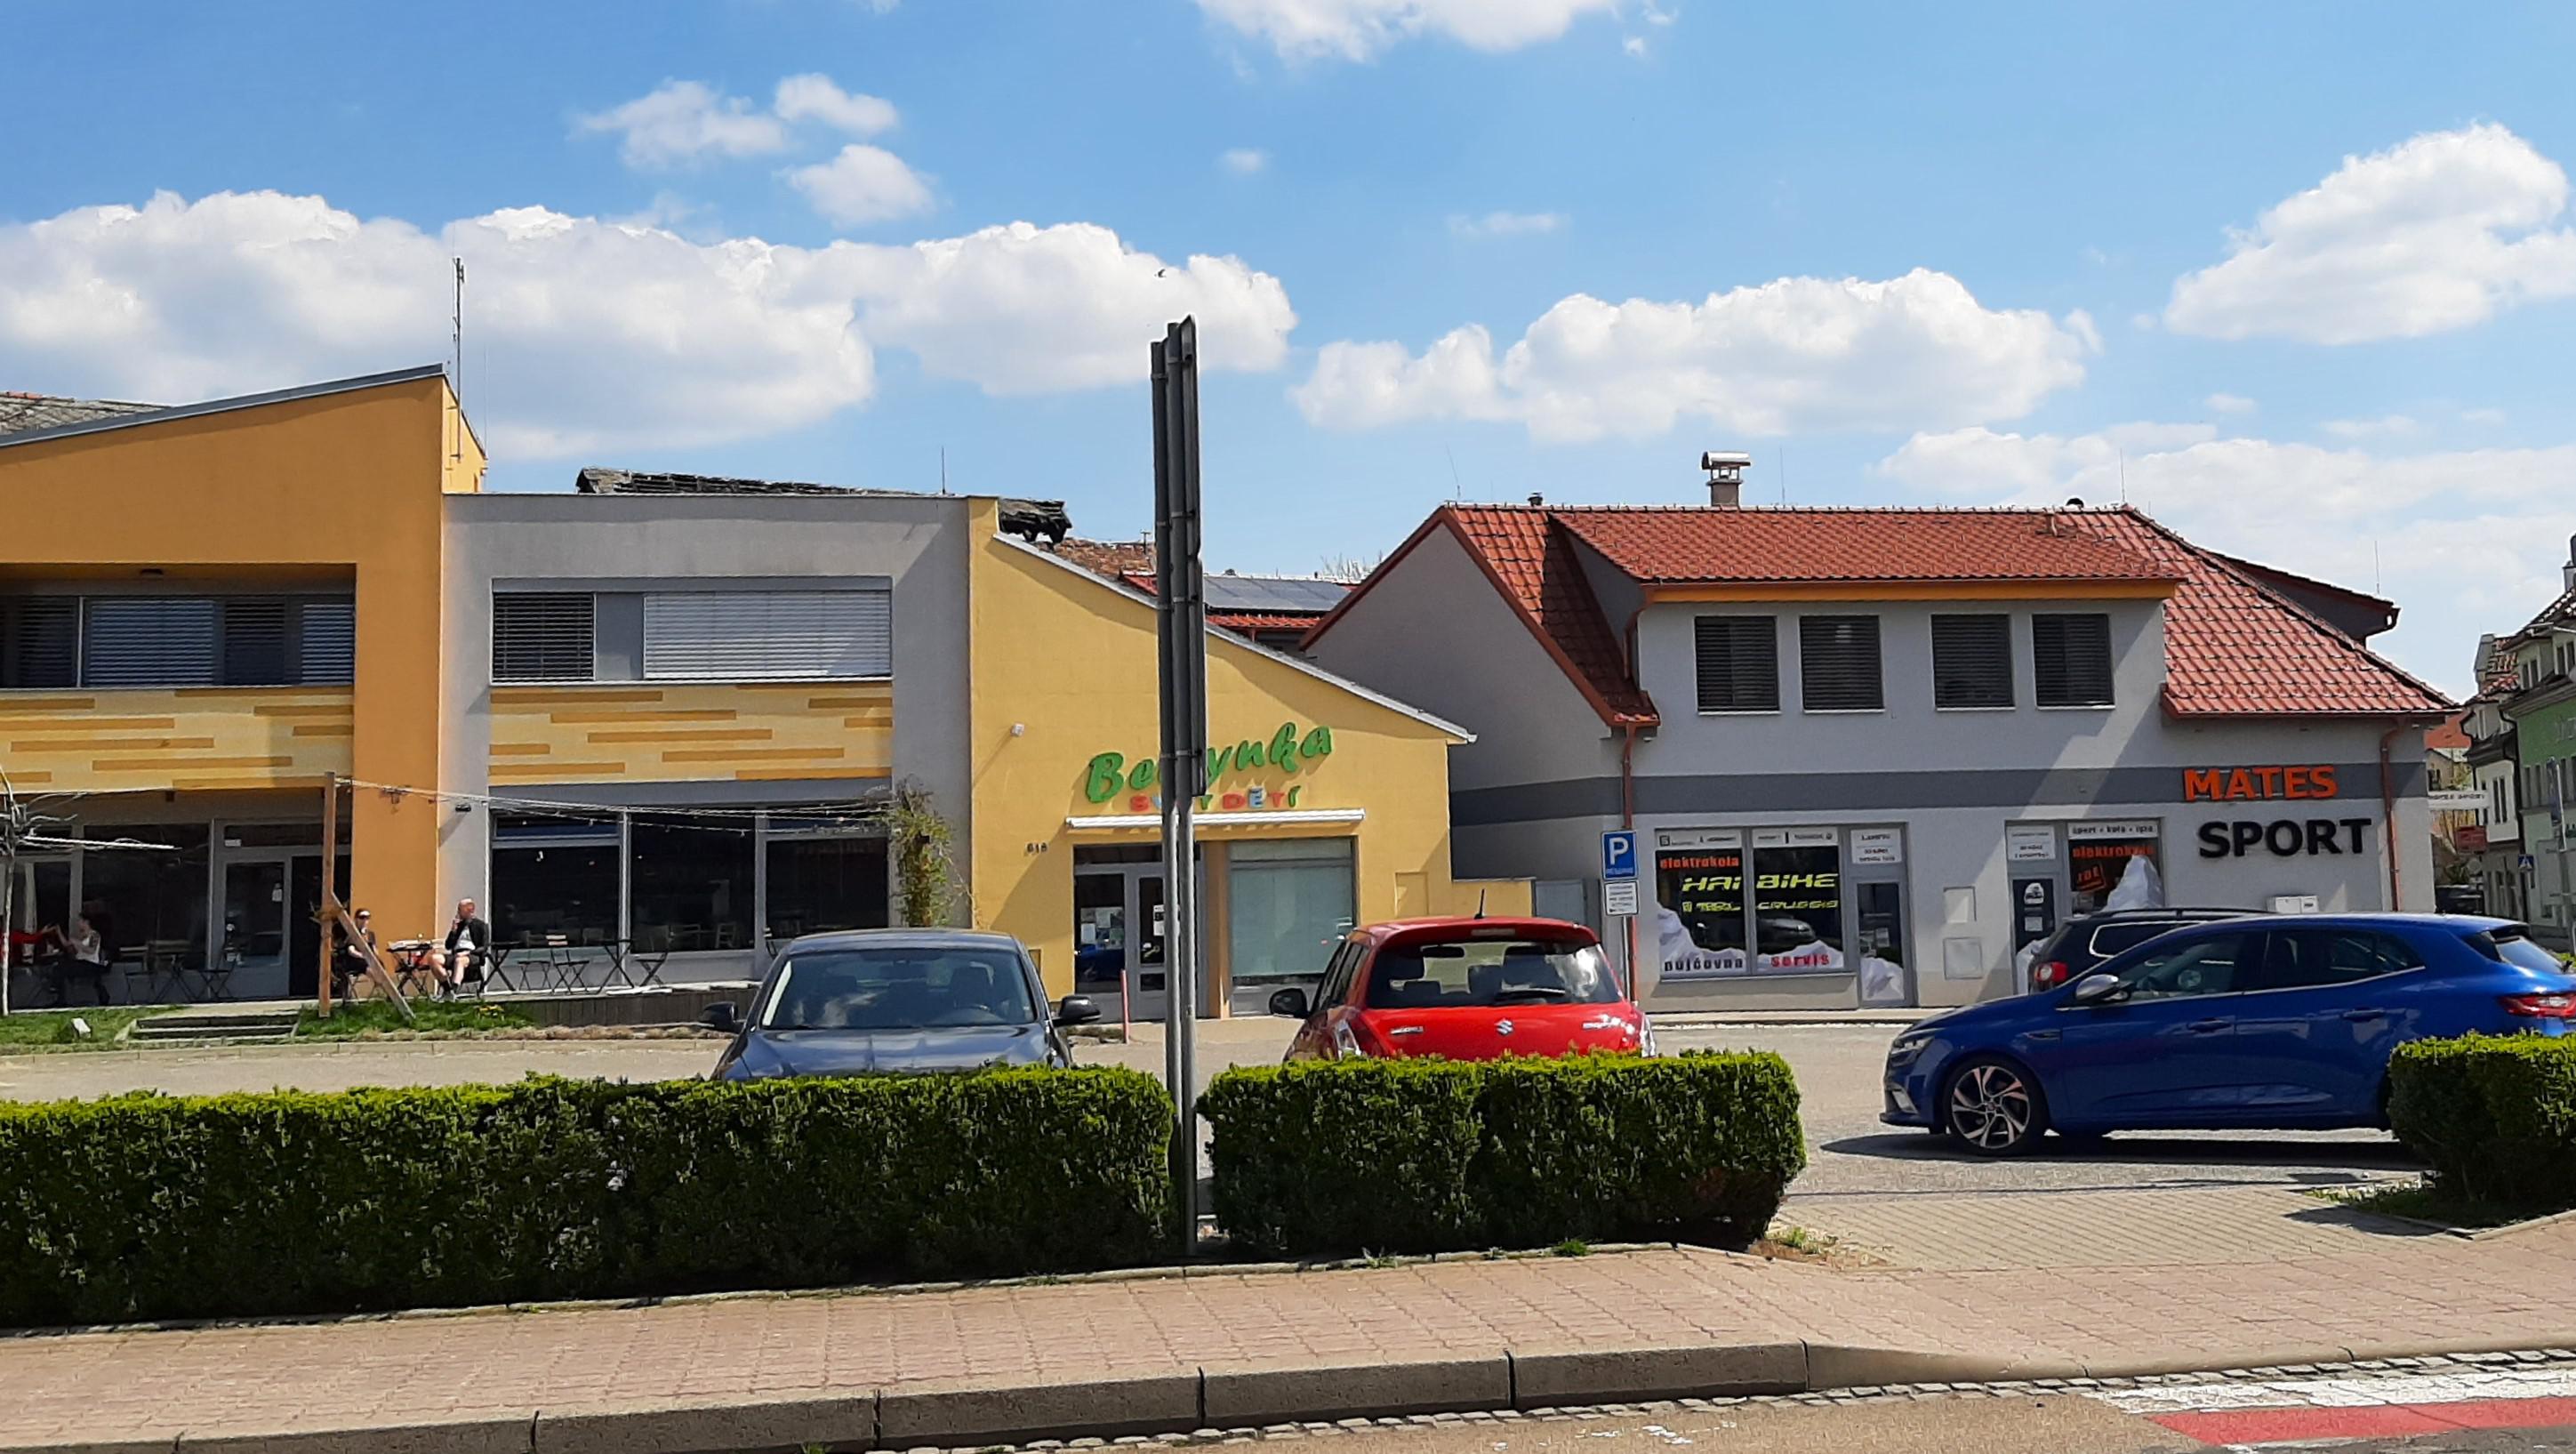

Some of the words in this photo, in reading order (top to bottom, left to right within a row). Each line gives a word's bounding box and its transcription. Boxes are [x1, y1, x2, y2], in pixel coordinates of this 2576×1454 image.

[1085, 721, 1333, 804] Beynka
[2183, 765, 2340, 801] MATES
[1609, 837, 1629, 865] P
[2196, 817, 2372, 859] SPORT
[1659, 856, 1740, 869] elektrokola
[1770, 952, 1830, 968] servis
